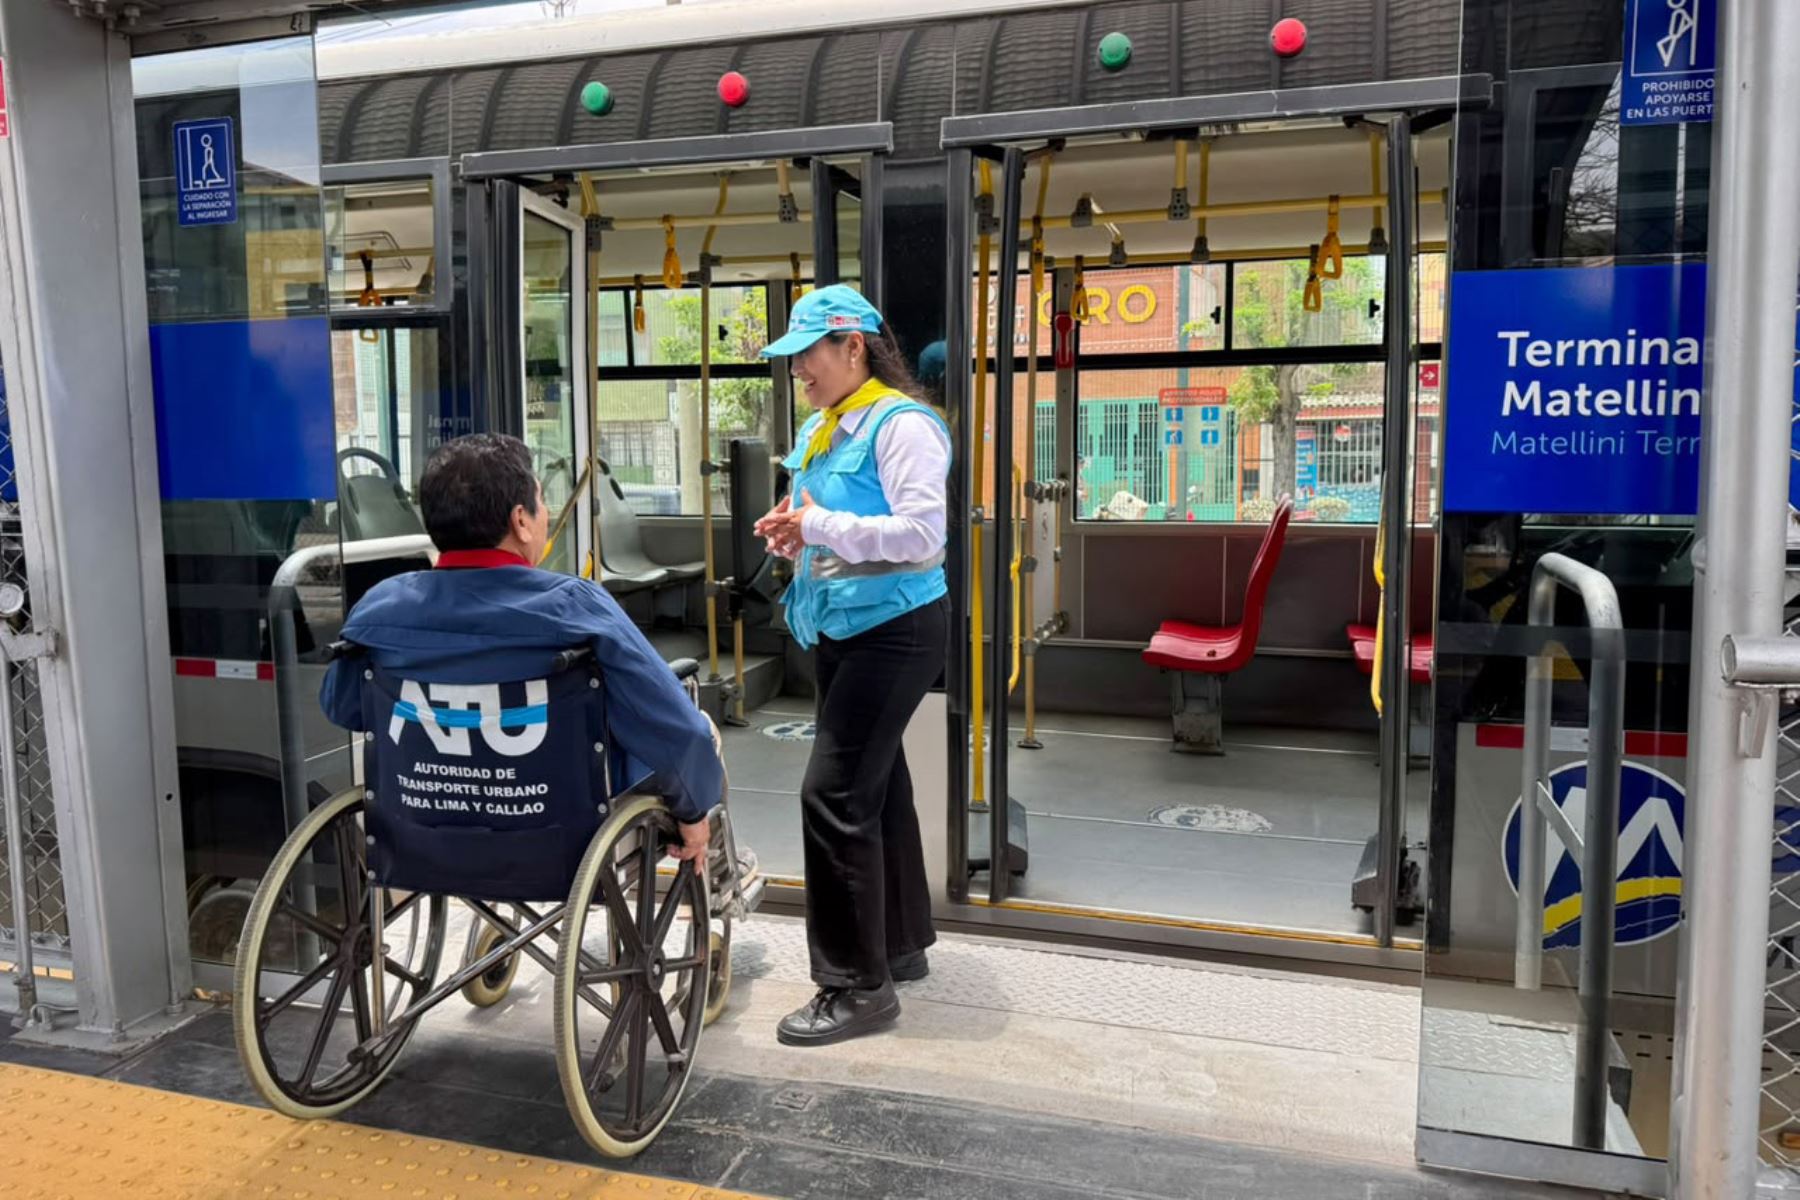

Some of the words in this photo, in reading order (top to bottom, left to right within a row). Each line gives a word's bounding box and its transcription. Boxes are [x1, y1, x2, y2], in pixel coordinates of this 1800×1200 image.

[1642, 78, 1715, 93] PROHIBIDO
[1645, 91, 1711, 105] APOYARSE
[1626, 108, 1643, 119] EN
[1647, 107, 1669, 118] LAS
[1671, 103, 1714, 116] PUERT
[215, 191, 230, 199] CON
[1497, 329, 1699, 368] Termina
[1501, 379, 1701, 417] Matellin
[1491, 430, 1625, 455] Matellini
[1636, 430, 1701, 455] Terr
[388, 679, 548, 757] ATU
[413, 761, 491, 780] AUTORIDAD
[495, 768, 517, 780] DE
[397, 774, 480, 796] TRANSPORTE
[483, 784, 549, 798] URBANO
[401, 793, 431, 810] PARA
[434, 799, 470, 812] LIMA
[472, 802, 482, 812] Y
[485, 802, 545, 815] CALLAO
